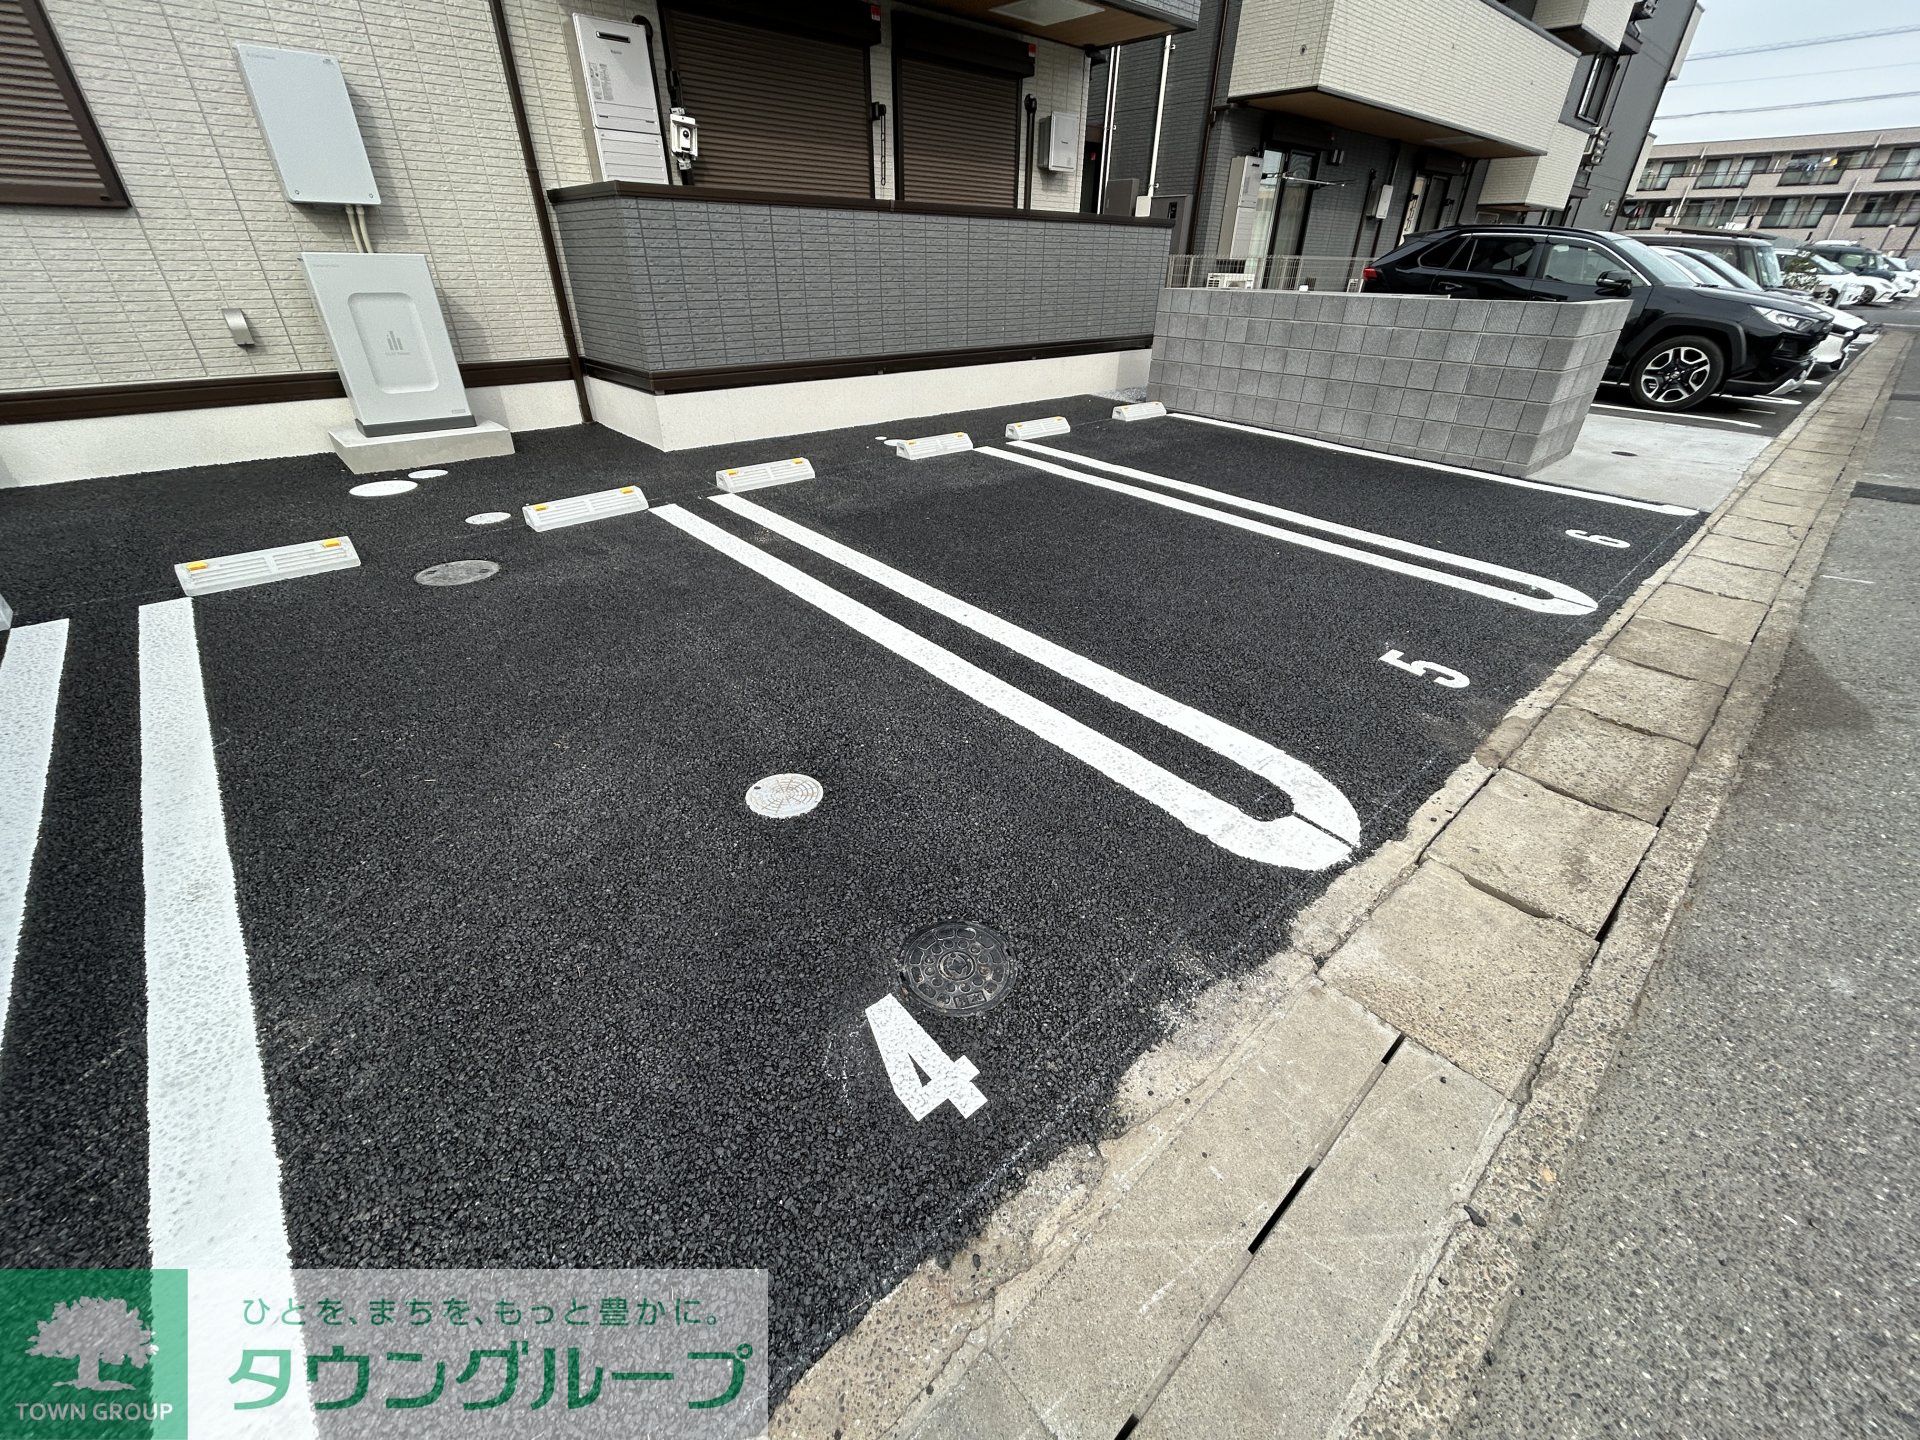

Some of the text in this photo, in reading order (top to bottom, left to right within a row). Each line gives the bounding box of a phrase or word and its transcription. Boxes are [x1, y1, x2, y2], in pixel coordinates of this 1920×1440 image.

[1565, 529, 1631, 548] 6
[1378, 649, 1470, 689] 5
[865, 993, 988, 1121] 4
